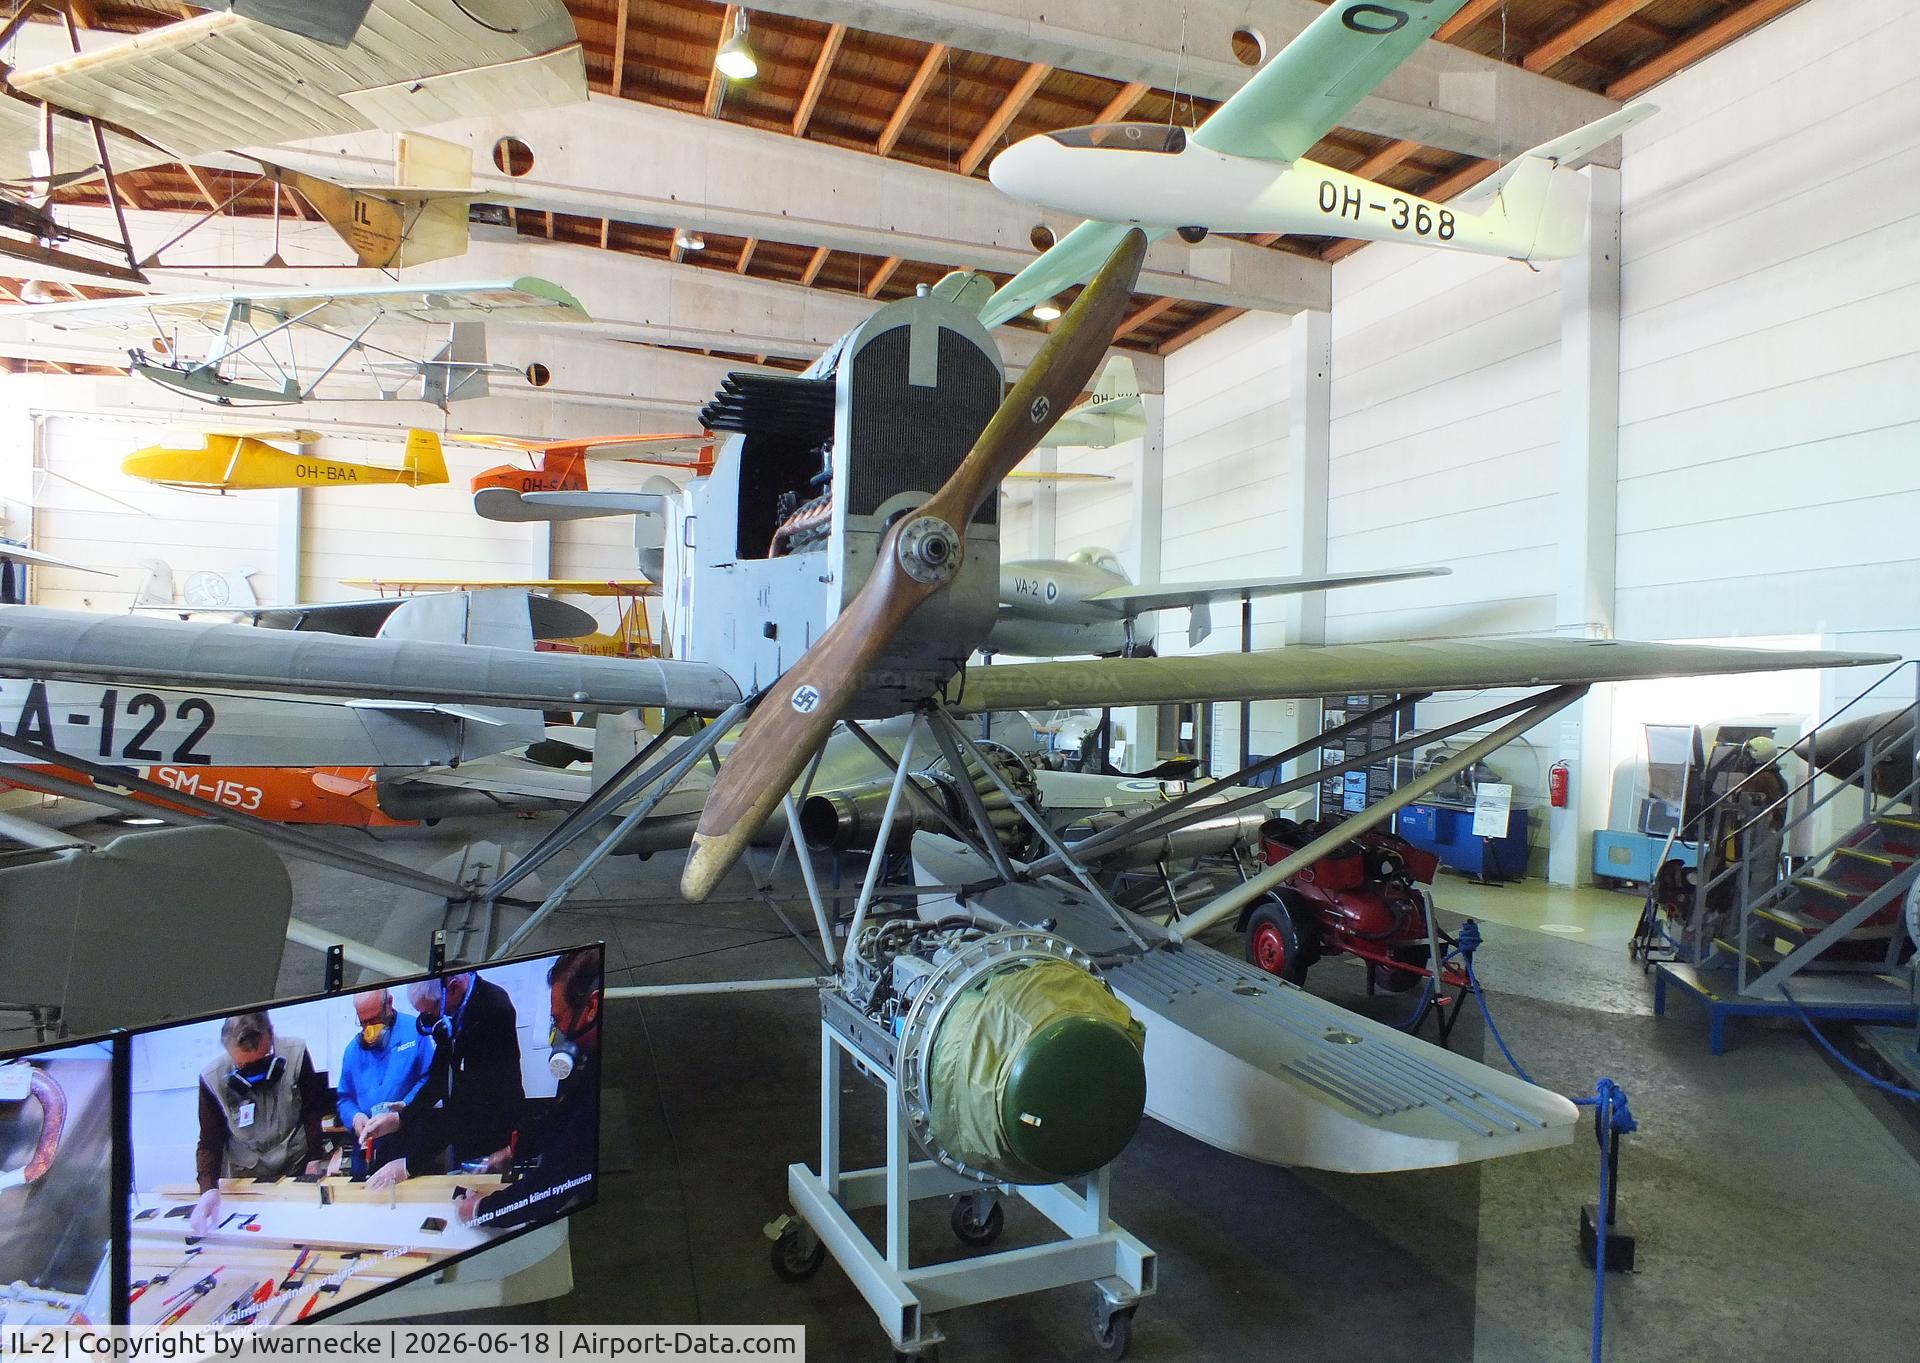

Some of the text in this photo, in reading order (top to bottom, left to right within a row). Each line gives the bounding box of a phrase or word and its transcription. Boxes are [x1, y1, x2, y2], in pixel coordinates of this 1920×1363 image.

[354, 199, 372, 226] IL
[1318, 179, 1456, 241] OH-368
[296, 464, 358, 481] OH-BAA
[1014, 577, 1039, 596] VA-2
[0, 682, 216, 765] A-122
[158, 766, 263, 810] SM-153
[529, 1186, 552, 1205] kiinni
[551, 1172, 592, 1196] syyskuussa
